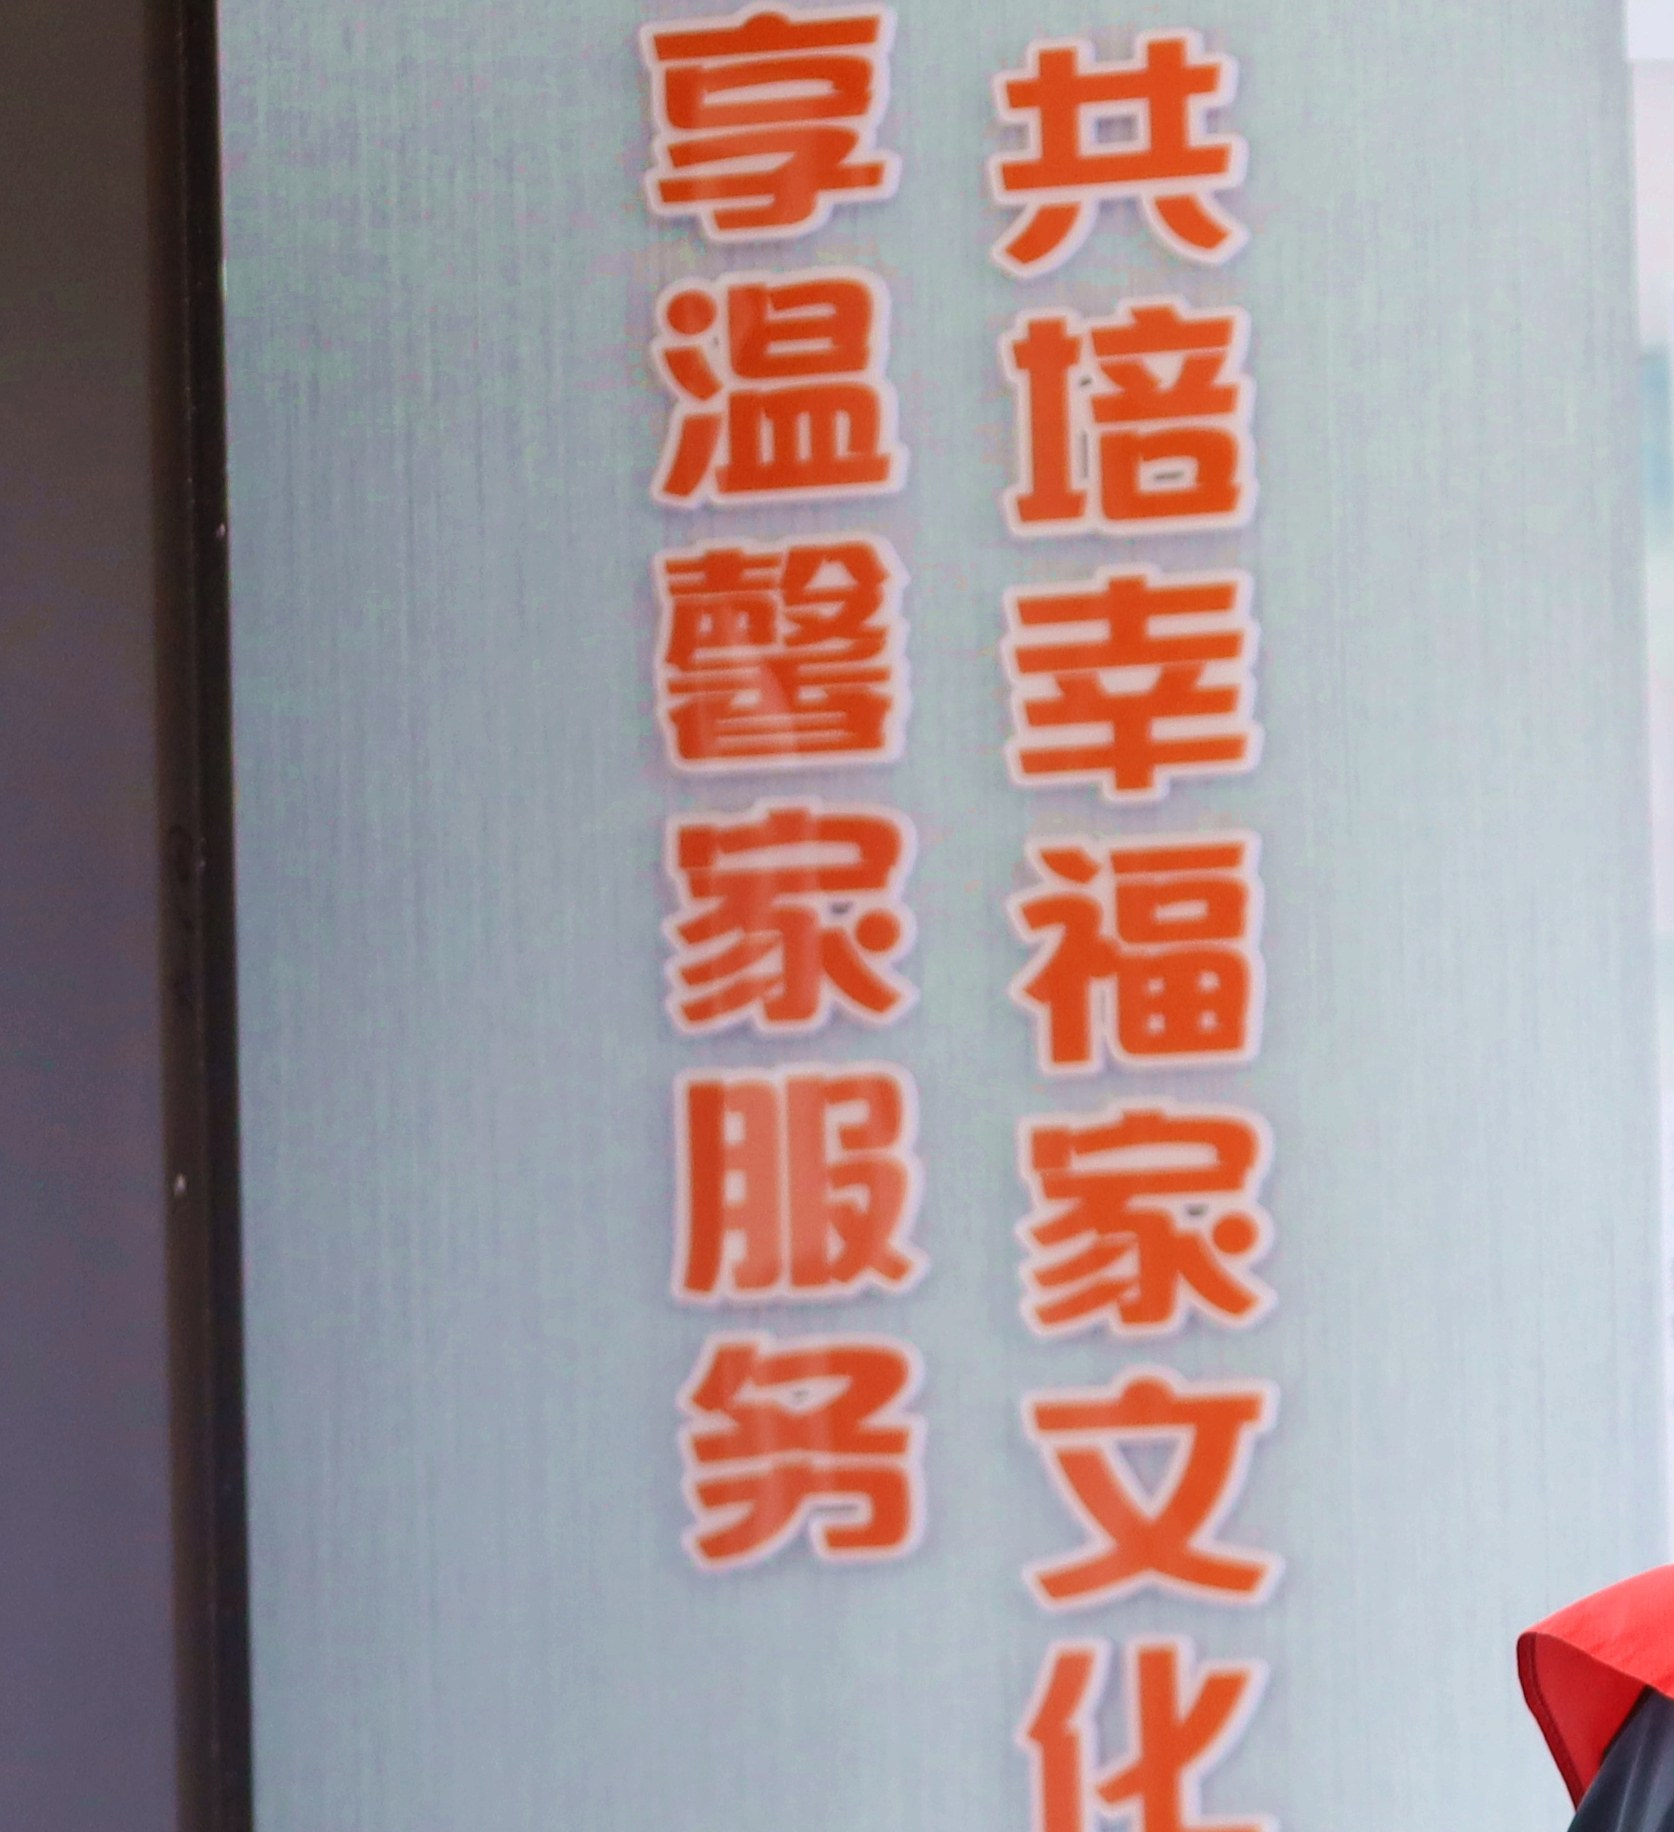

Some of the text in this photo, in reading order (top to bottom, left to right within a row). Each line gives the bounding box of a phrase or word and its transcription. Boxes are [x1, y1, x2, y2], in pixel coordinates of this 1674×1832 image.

[650, 10, 910, 1561] 享温馨家服务
